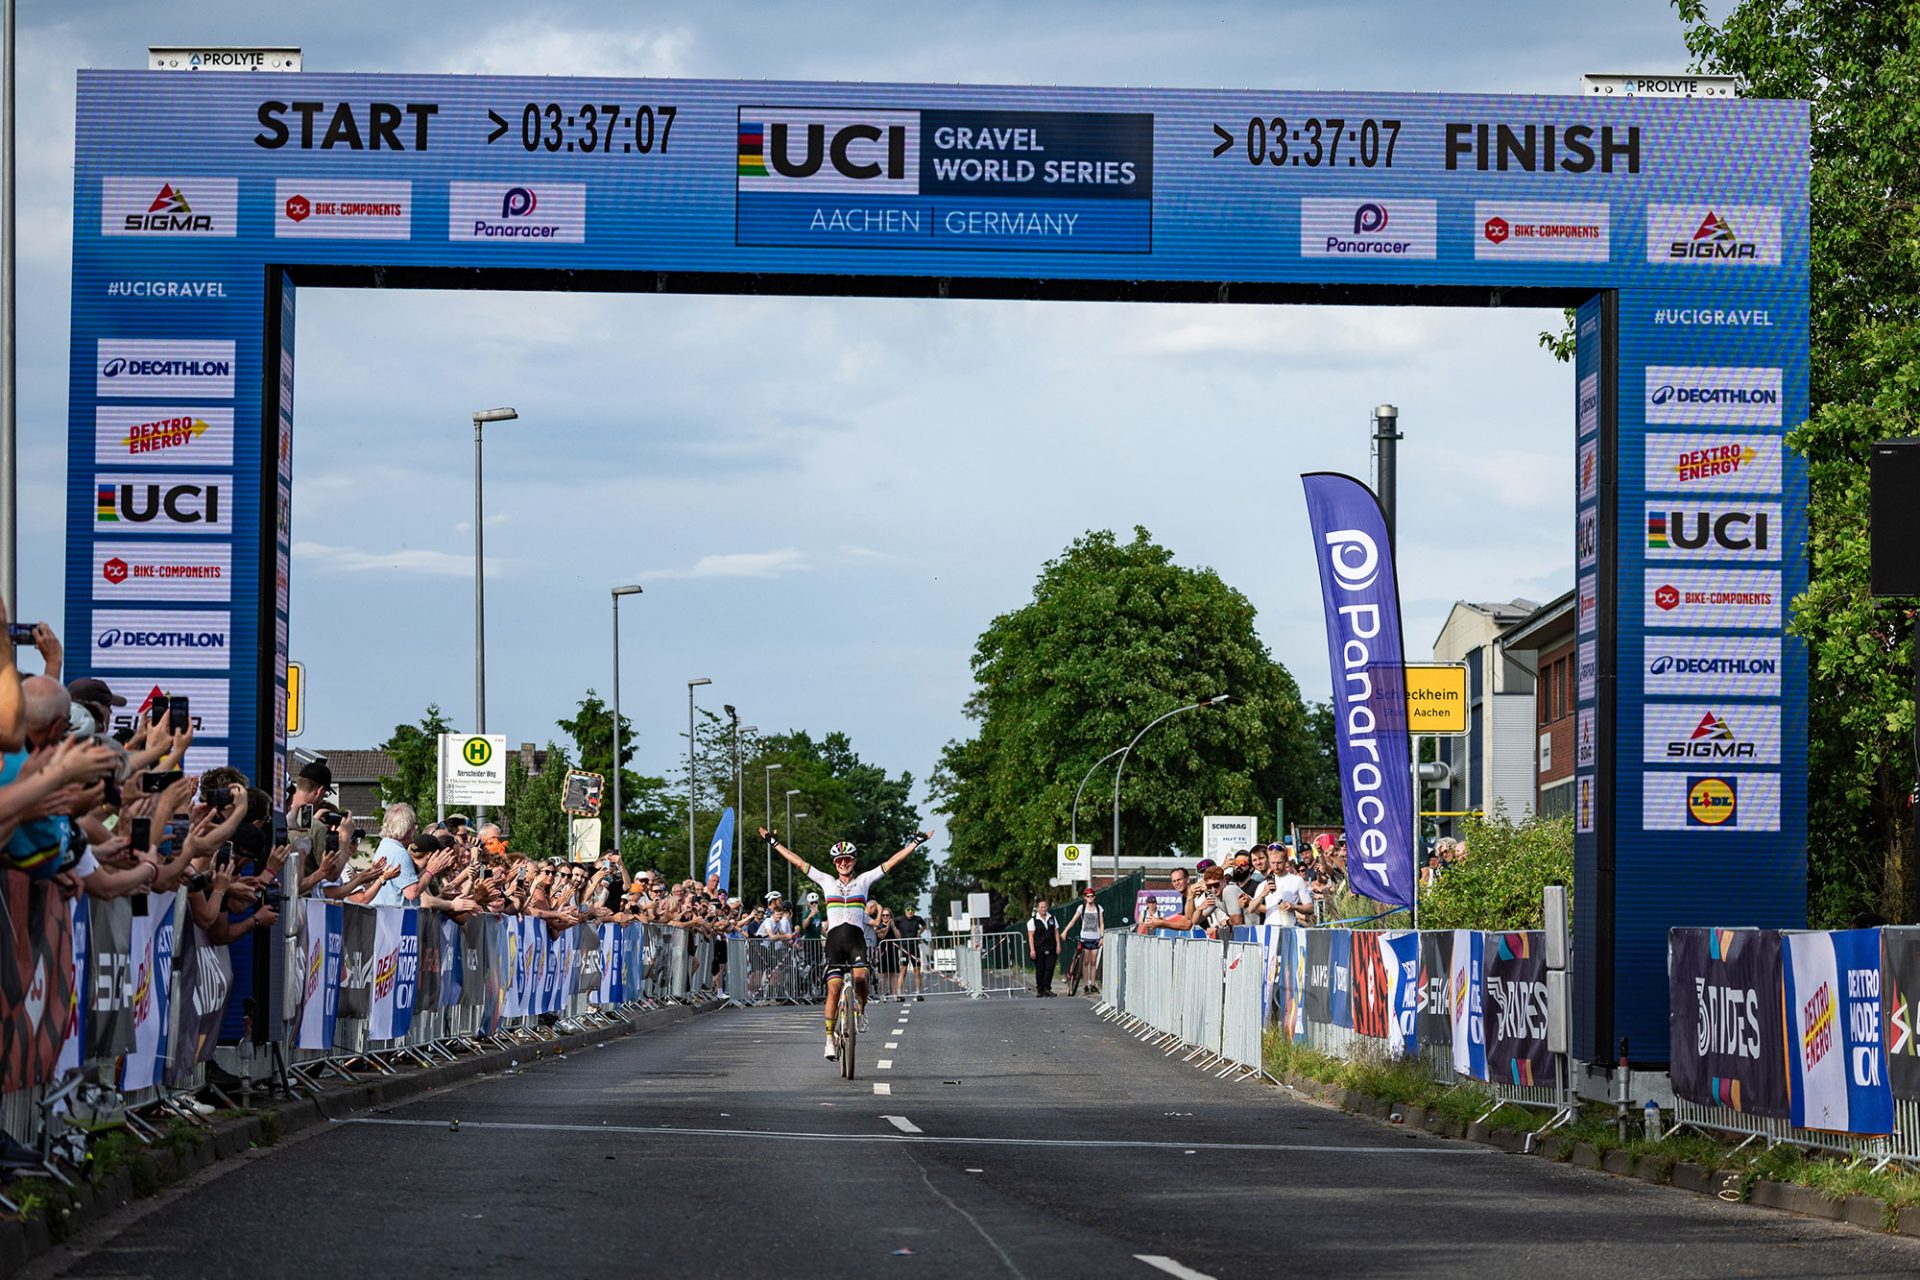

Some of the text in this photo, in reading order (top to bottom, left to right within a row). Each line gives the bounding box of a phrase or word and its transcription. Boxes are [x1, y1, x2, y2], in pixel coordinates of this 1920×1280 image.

[203, 51, 265, 66] PROLYTE
[1636, 79, 1698, 94] PROLYTE
[254, 100, 439, 152] START
[521, 102, 678, 154] 03:37:07
[769, 123, 906, 180] UCI
[933, 127, 1045, 152] GRAVEL
[1246, 116, 1402, 168] 03:37:07
[1445, 122, 1642, 174] FINISH
[933, 158, 1137, 185] WORLD SERIES
[315, 201, 402, 218] BIKE-COMPONENTS
[809, 207, 1080, 236] AACHEN GERMANY
[473, 220, 560, 239] Panaracer
[1514, 224, 1600, 240] BIKE-COMPONENTS
[1326, 237, 1412, 255] Panaracer
[107, 281, 228, 299] #UCIGRAVEL
[1654, 309, 1774, 327] #UCIGRAVEL
[128, 360, 229, 378] DECATHLON
[1677, 388, 1776, 405] DECATHLON
[129, 416, 193, 440] DEXTRO
[129, 431, 193, 455] ENERGY
[1679, 443, 1742, 466] DEXTRO
[1679, 460, 1742, 482] ENERGY
[120, 484, 219, 523] UCI
[1670, 512, 1768, 551] UCI
[133, 564, 221, 580] BIKE-COMPONENTS
[1685, 591, 1772, 607] BIKE-COMPONENTS
[123, 632, 225, 649] DECATHLON
[1675, 657, 1776, 675] DECATHLON
[1414, 708, 1451, 717] Aachen
[1338, 603, 1390, 888] Panaracer
[1848, 969, 1880, 998] DEXTRO
[1804, 980, 1829, 1034] DEXTRO
[1849, 1002, 1880, 1043] MODE
[1805, 1018, 1833, 1073] ENERGY
[1852, 1046, 1881, 1087] ON
